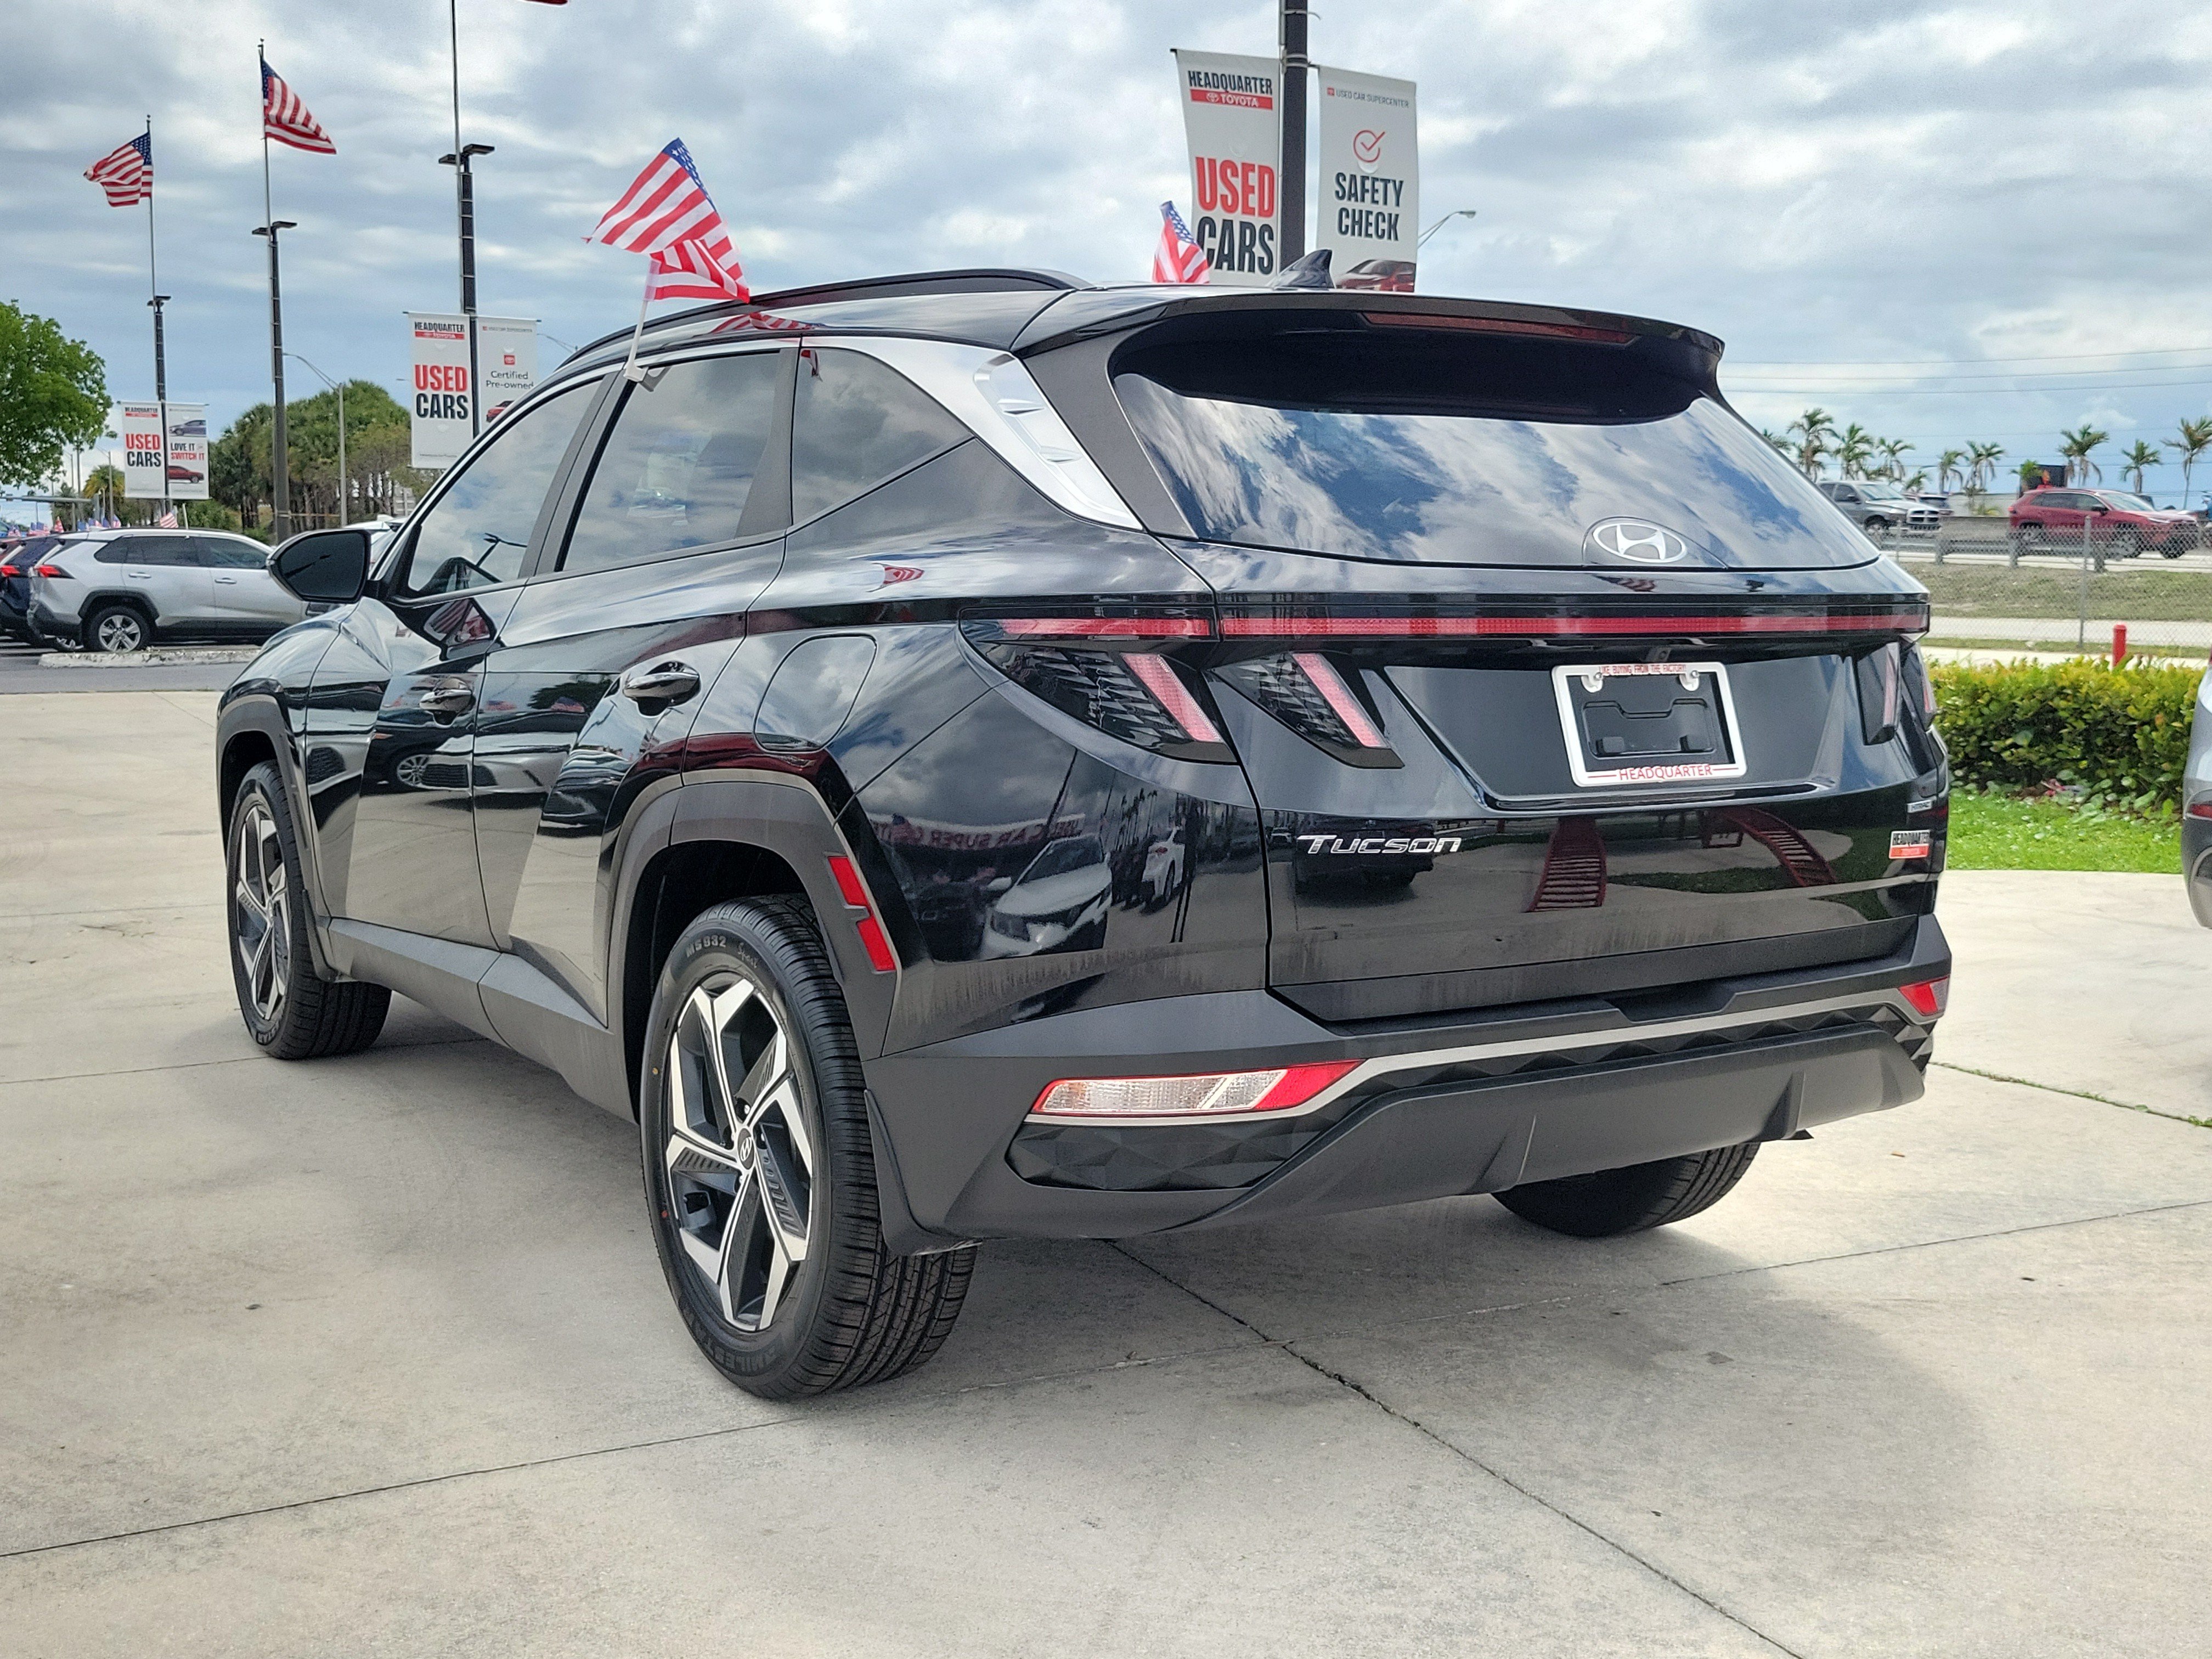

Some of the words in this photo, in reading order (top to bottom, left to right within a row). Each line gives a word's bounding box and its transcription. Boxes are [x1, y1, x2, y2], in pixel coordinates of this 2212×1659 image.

[1188, 70, 1273, 95] HEADQUARTER
[1220, 94, 1259, 108] TOYOTA
[1336, 89, 1352, 99] USED
[1353, 92, 1365, 101] CAR
[1195, 157, 1274, 218] USED
[1334, 172, 1404, 207] SAFETY
[1338, 207, 1400, 241] CHECK
[1197, 217, 1274, 275] CARS
[414, 321, 465, 332] HEADQUARTER
[414, 364, 467, 392] USED
[490, 371, 528, 380] Certified
[486, 380, 533, 389] Pre-owned
[416, 393, 469, 420] CARS
[126, 433, 161, 450] USED
[171, 443, 187, 452] LOVE
[127, 451, 161, 467] CARS
[171, 452, 196, 460] SWITCH
[198, 453, 205, 461] IT
[1619, 765, 1712, 781] HEADQUARTER
